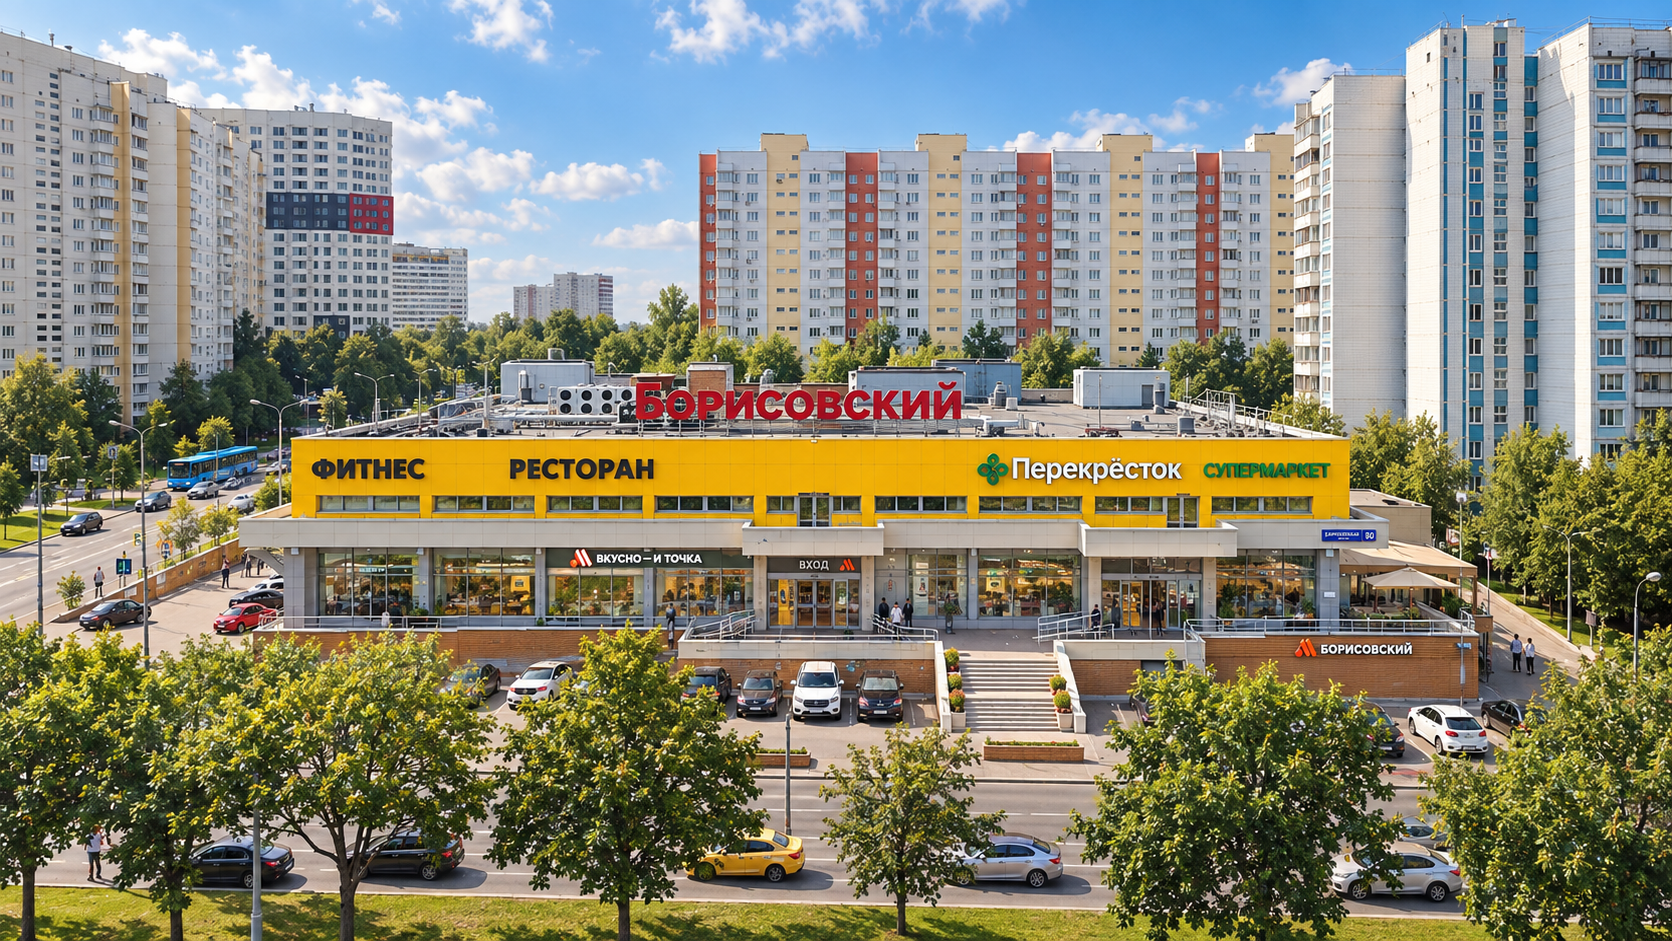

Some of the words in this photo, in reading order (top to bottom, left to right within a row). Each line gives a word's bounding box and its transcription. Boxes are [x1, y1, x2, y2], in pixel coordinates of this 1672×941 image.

[311, 458, 426, 480] ФИТНЕС
[509, 458, 655, 480] РЕСТОРАН
[1012, 457, 1183, 485] Перекрёсток
[1203, 462, 1332, 479] СУПЕРМАРКЕТ
[596, 554, 642, 564] ВКУСНО
[653, 554, 662, 564] И
[663, 554, 703, 564] ТОЧКА
[799, 560, 830, 571] ВХОД
[1320, 641, 1413, 655] БОРИСОВСКИЙ
